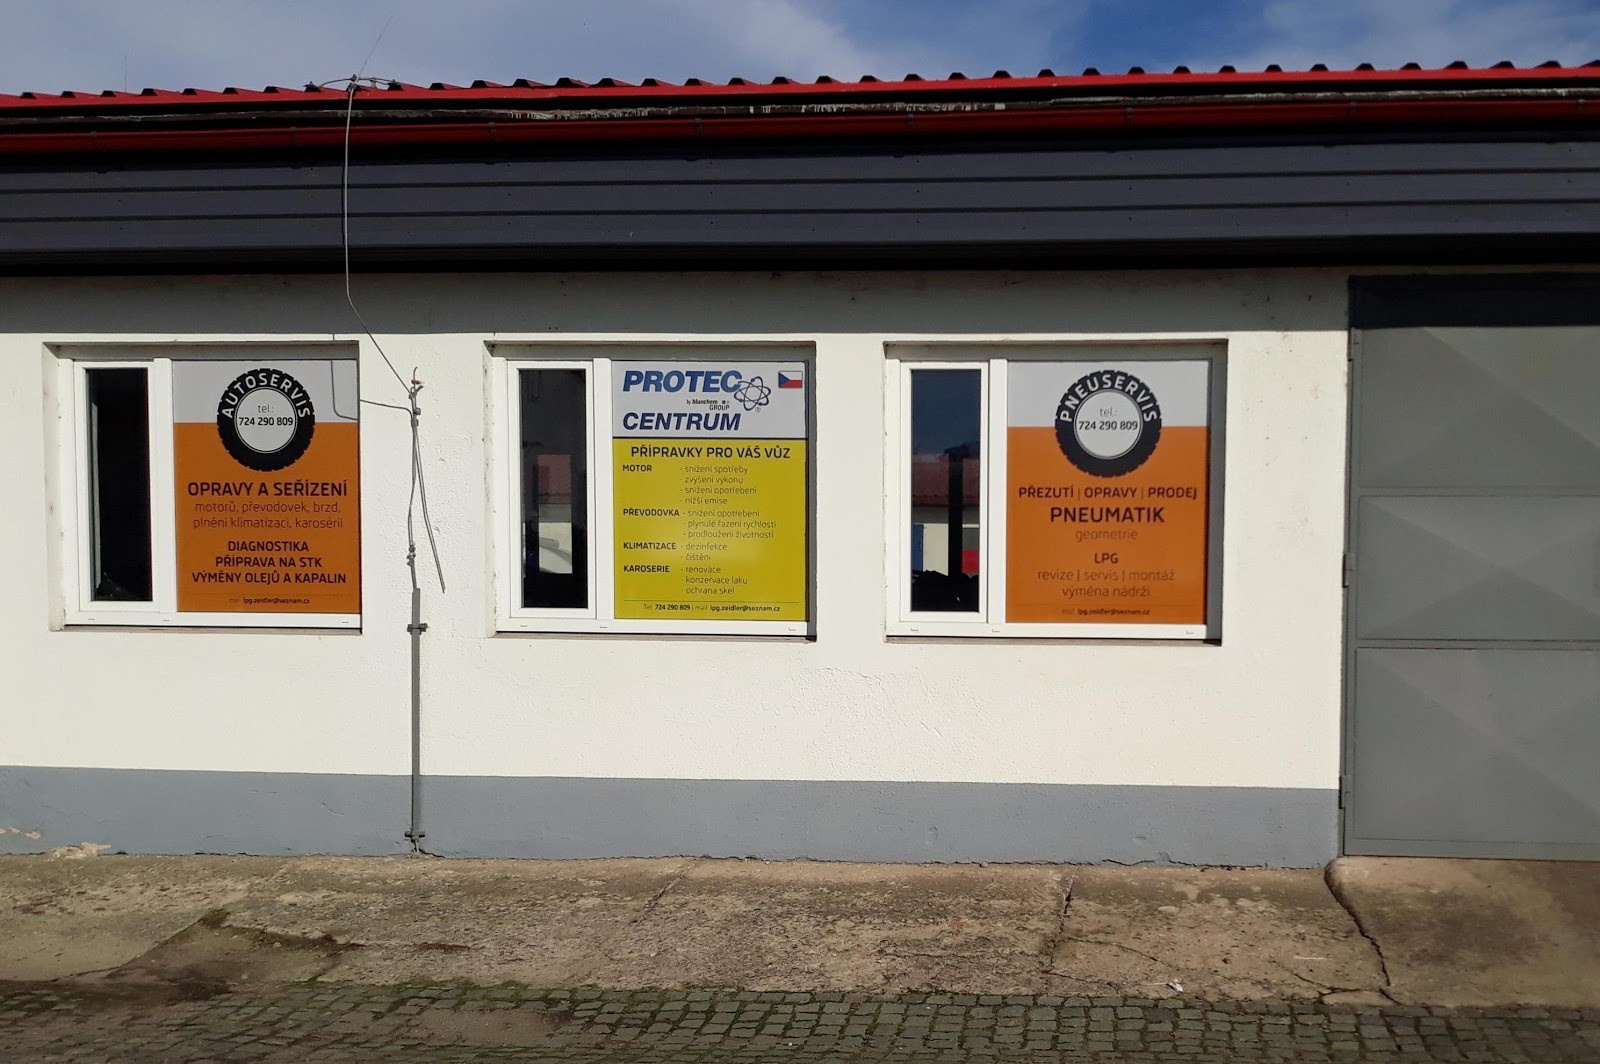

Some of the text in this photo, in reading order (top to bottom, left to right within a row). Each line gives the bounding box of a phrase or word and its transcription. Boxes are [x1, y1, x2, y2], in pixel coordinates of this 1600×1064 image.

[622, 370, 742, 393] PROTEC
[221, 372, 311, 419] AUTOSERVIS
[1060, 374, 1157, 423] PNEUSERVIS
[257, 404, 274, 414] tel.:
[1100, 406, 1118, 417] tel.:
[239, 417, 293, 426] 724 290 809
[623, 413, 741, 431] CENTRUM
[1078, 421, 1138, 430] 724 290 809
[631, 444, 791, 459] PŘÍPRAVKY PRO VÁŠ VŮZ
[622, 464, 653, 472] MOTOR
[714, 465, 748, 476] spotřeby
[187, 479, 347, 497] OPRAVY A SEŘÍZENÍ
[1018, 485, 1197, 500] PŘEZUTÍ OPRAVY PRODEJ
[195, 501, 341, 514] motorů, převodovek, brzd,
[623, 506, 680, 517] PŘEVODOVKA
[1050, 507, 1165, 523] PNEUMATIK
[193, 517, 227, 530] plnění
[230, 517, 292, 530] klimatizací,
[1075, 530, 1138, 543] geometrie
[228, 541, 309, 552] DIAGNOSTIKA
[623, 542, 728, 551] KLIMATIZACE dezinfekce
[215, 554, 322, 568] PŘÍPRAVA NA STK
[1094, 553, 1119, 564] LPG
[623, 564, 671, 573] KAROSERIE
[1037, 569, 1074, 580] revize
[1083, 571, 1119, 581] servis
[192, 570, 347, 585] VÝMĚNY OLEJŮ A KAPALIN
[685, 577, 748, 585] konzervace laku
[685, 587, 735, 595] ochrana skel
[1062, 585, 1109, 599] výměna
